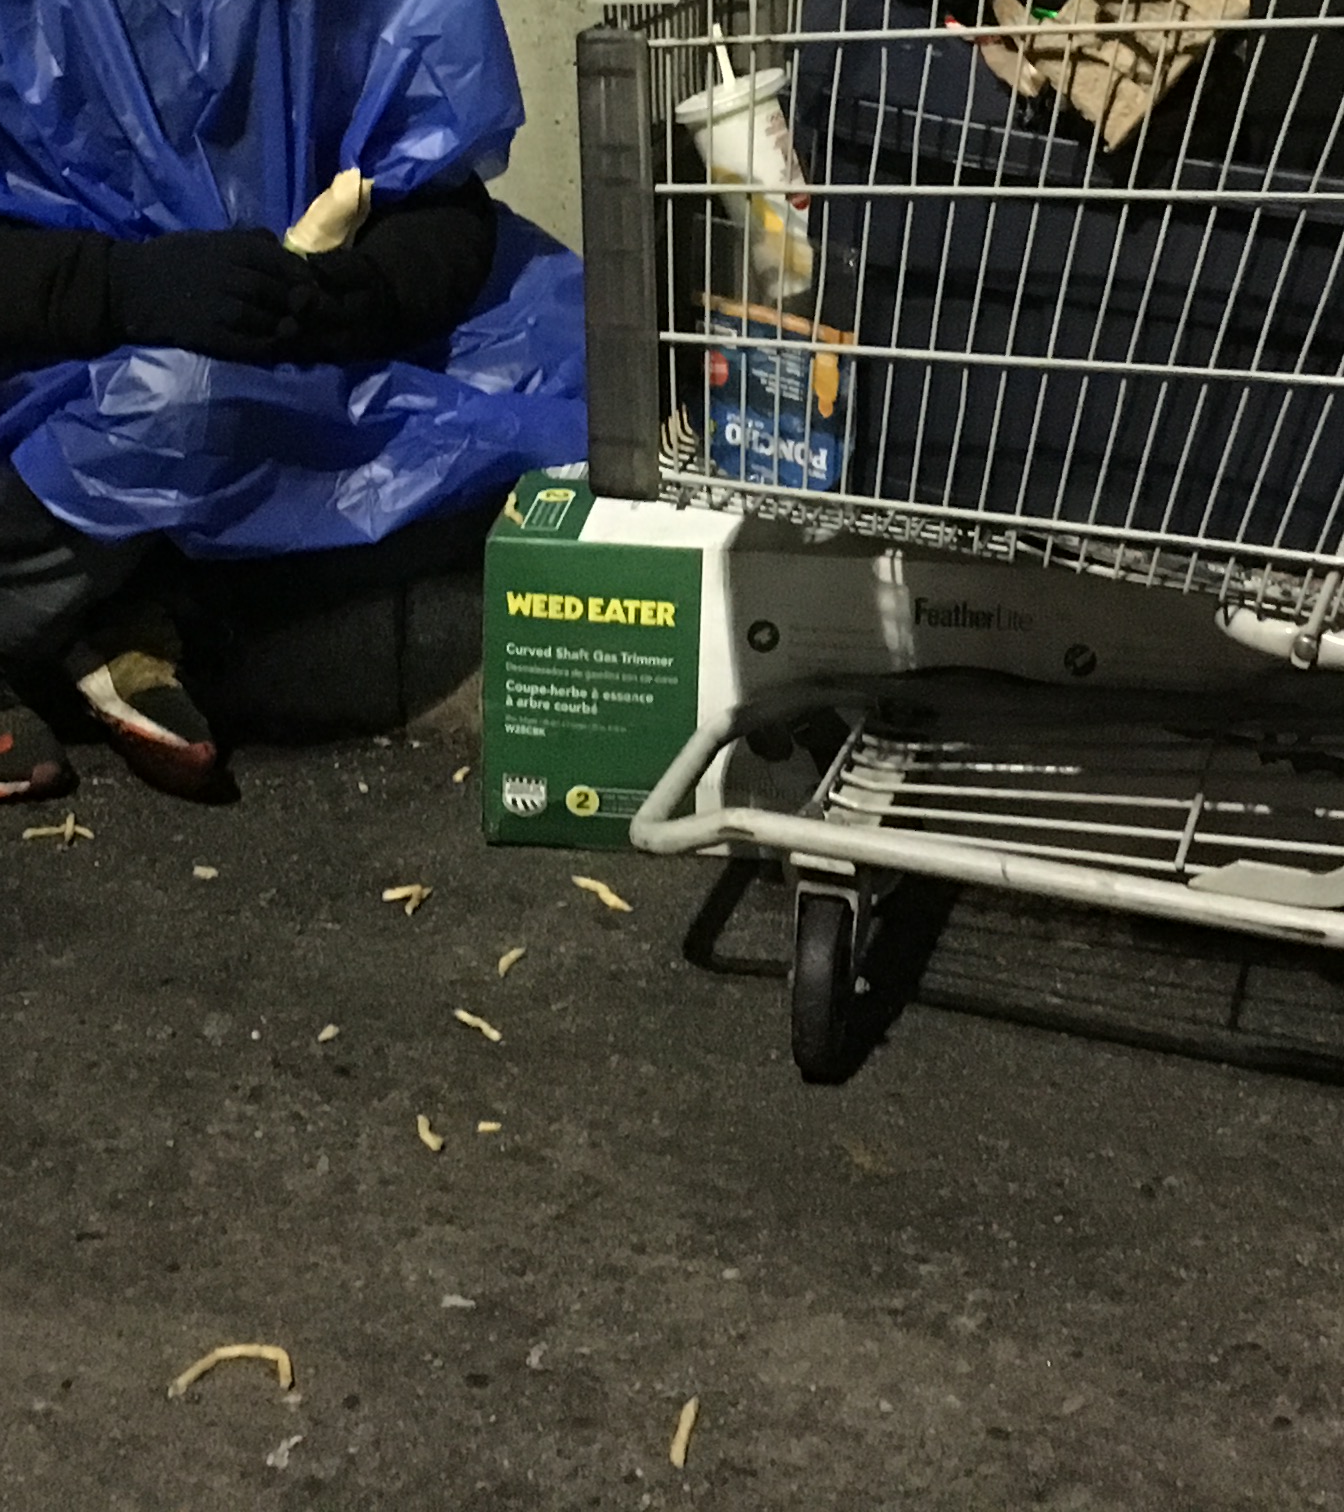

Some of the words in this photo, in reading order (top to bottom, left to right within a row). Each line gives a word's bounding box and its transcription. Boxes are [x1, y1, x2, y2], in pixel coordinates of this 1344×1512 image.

[506, 591, 584, 620] WEED
[587, 596, 676, 627] EATER
[914, 597, 1034, 632] FeatherLite
[506, 642, 552, 658] Curved
[556, 646, 589, 662] Shaft
[593, 650, 618, 664] Gas
[621, 651, 674, 667] Trimmer
[506, 680, 587, 699] Coupe-herbe
[517, 696, 550, 711] arbre
[576, 792, 590, 809] 2
